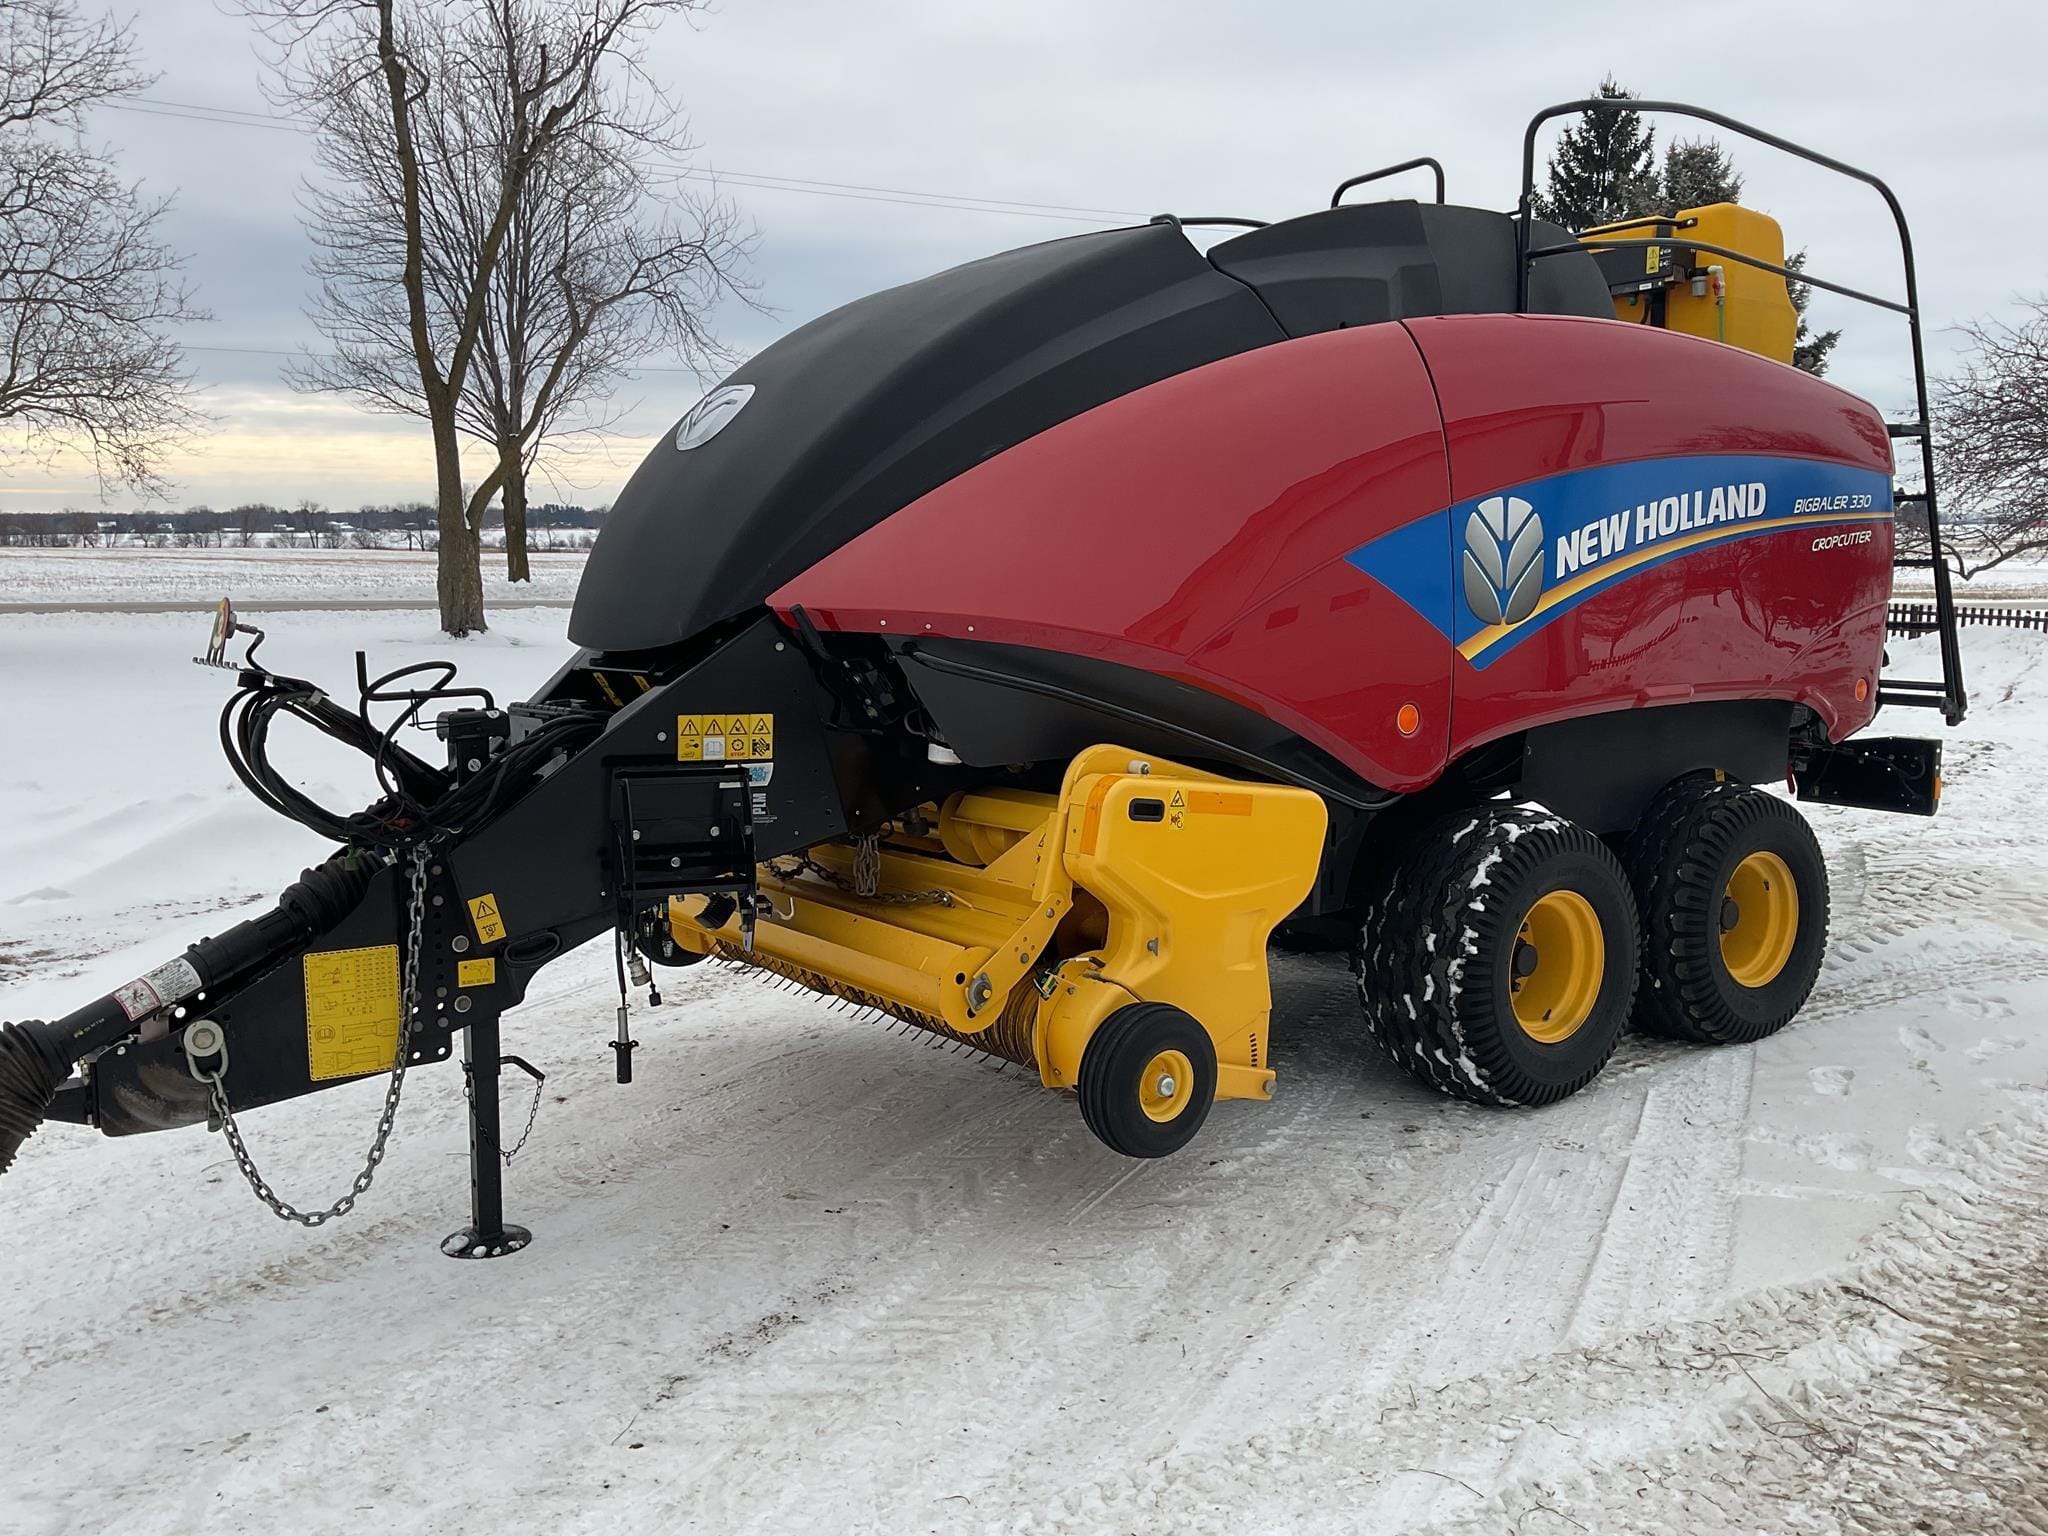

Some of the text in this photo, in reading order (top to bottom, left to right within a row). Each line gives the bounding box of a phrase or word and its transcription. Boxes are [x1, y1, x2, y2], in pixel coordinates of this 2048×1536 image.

[1793, 494, 1872, 514] BIGBALER 330
[1556, 482, 1767, 579] NEW HOLLAND
[1811, 530, 1872, 552] CROPCUTTER
[752, 793, 767, 815] PLM
